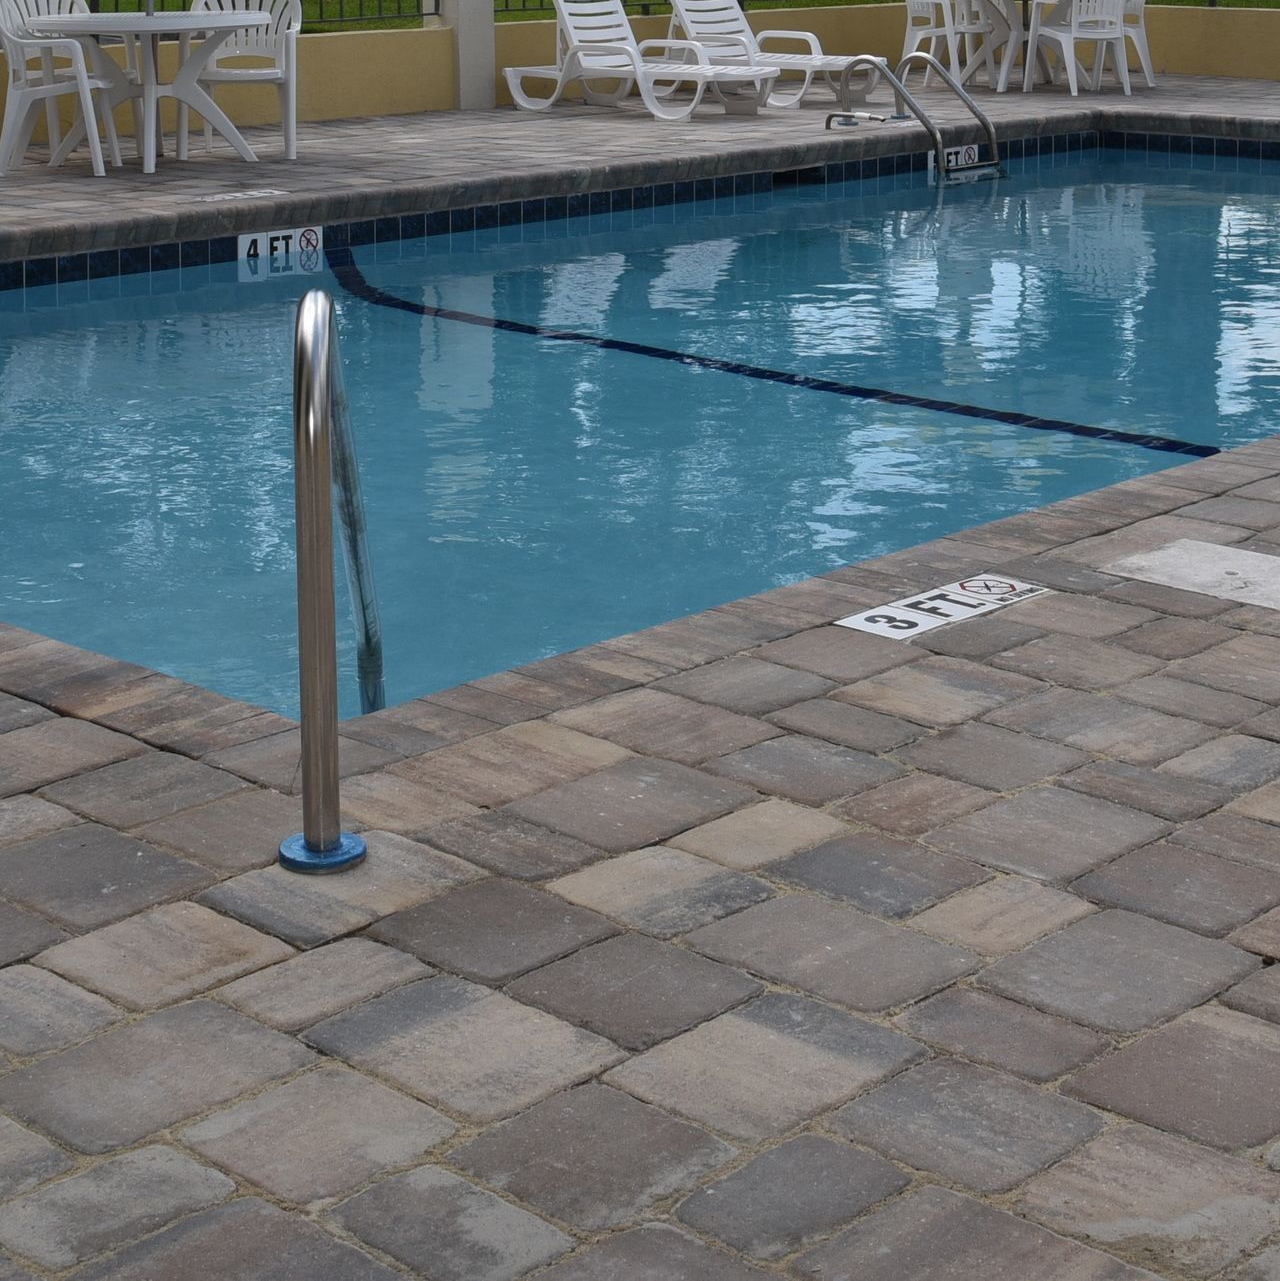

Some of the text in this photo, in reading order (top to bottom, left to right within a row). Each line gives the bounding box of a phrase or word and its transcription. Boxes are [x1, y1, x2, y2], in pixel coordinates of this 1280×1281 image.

[246, 235, 294, 260] 4 FT
[863, 614, 920, 630] 3
